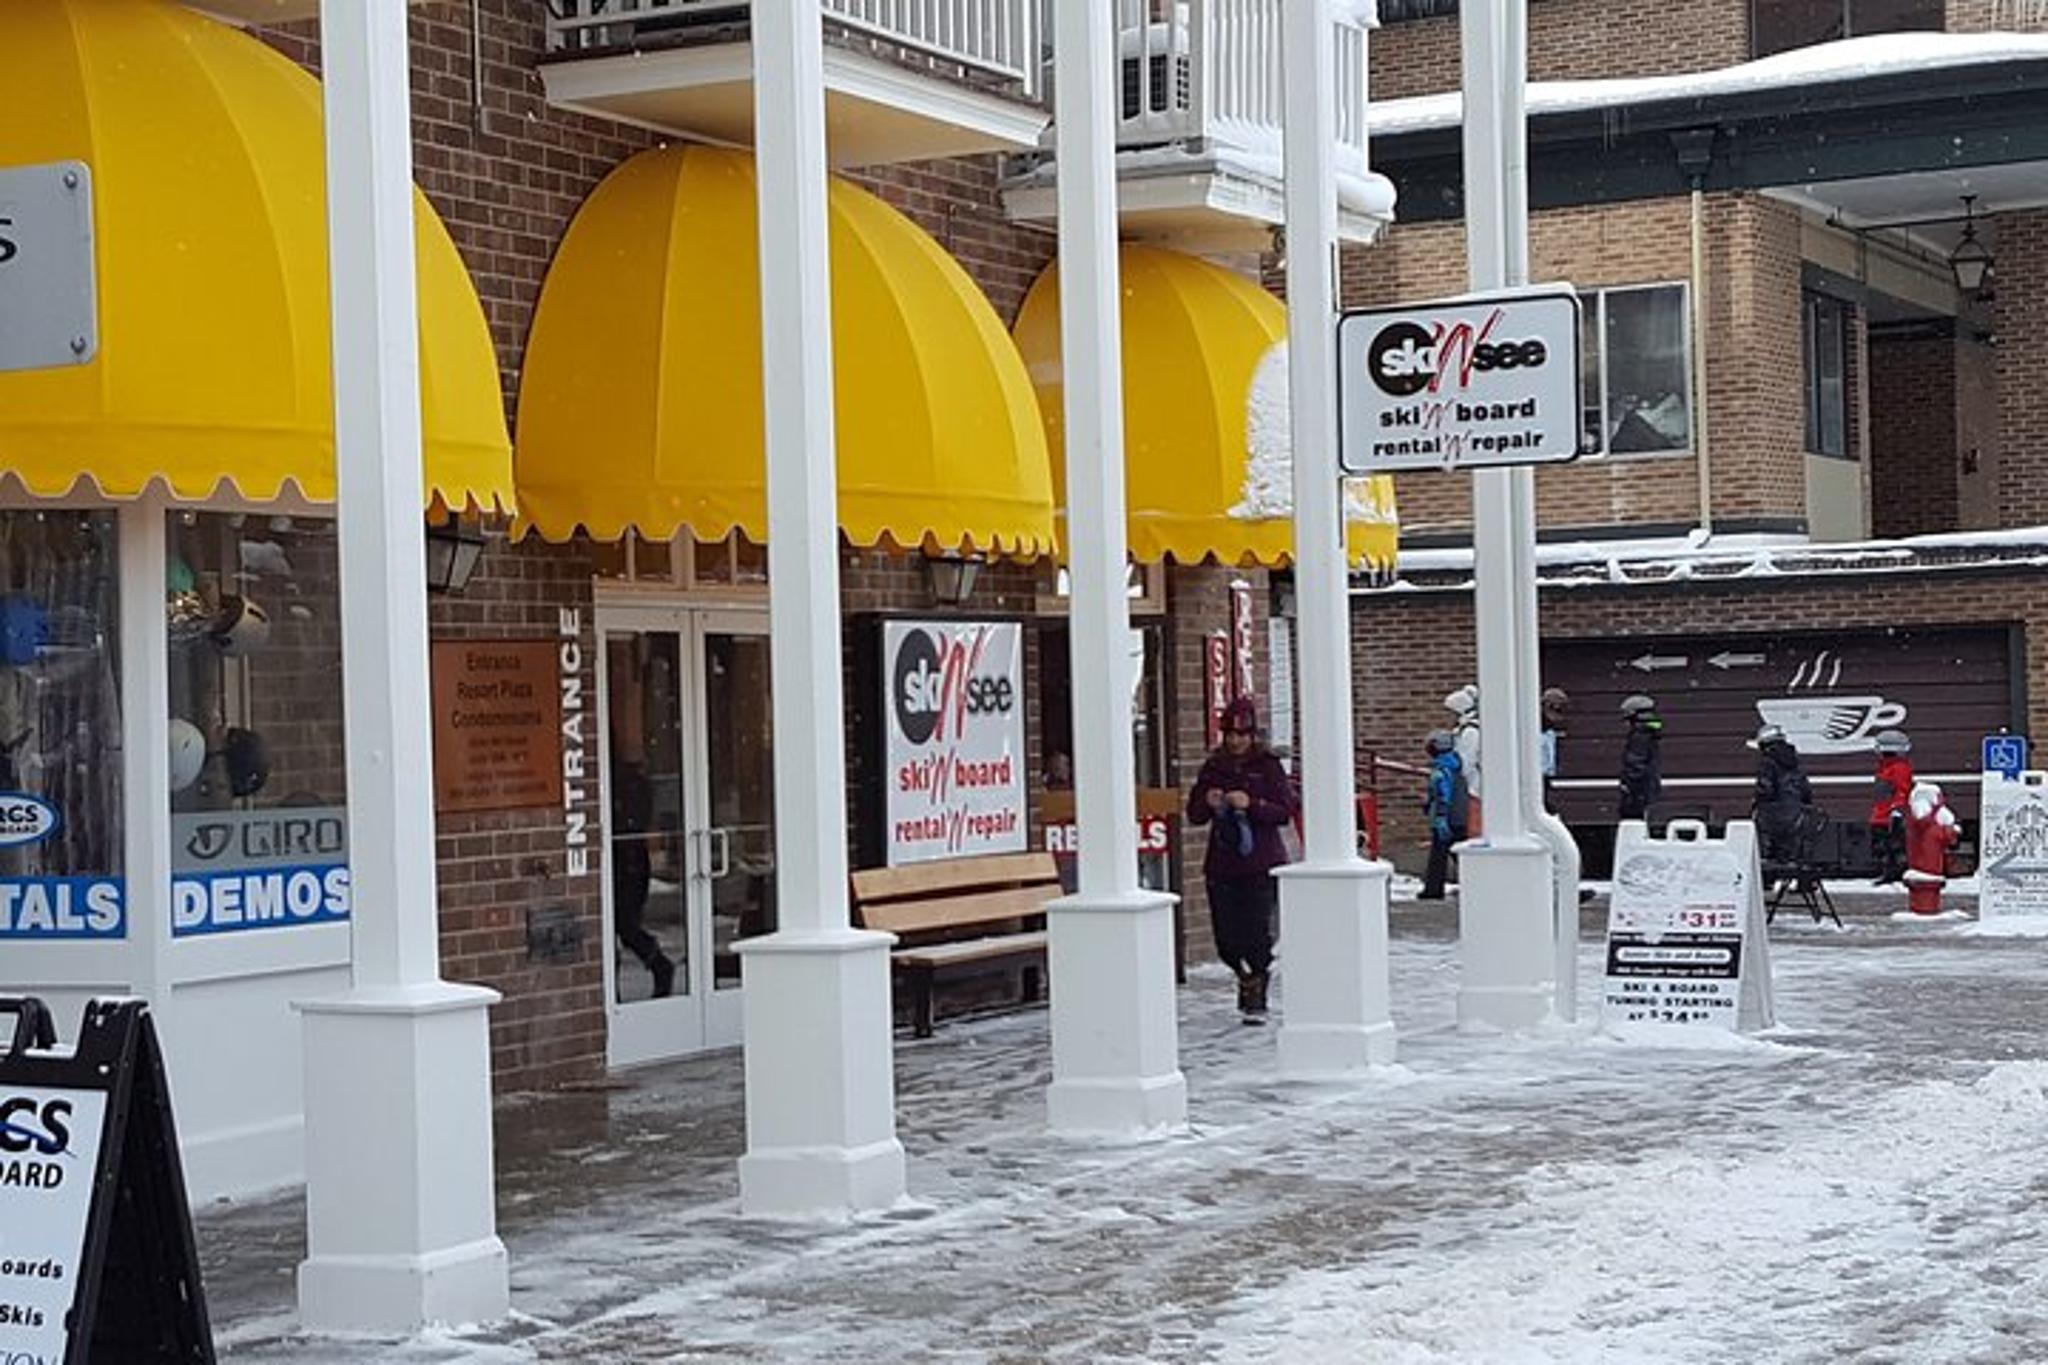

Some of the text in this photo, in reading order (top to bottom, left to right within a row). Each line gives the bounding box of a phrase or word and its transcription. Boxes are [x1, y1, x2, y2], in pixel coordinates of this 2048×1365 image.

[1379, 407, 1420, 428] ski
[1456, 398, 1536, 422] board
[1373, 436, 1441, 456] rental
[1472, 431, 1544, 454] repair
[559, 607, 588, 877] ENTRANCE
[899, 754, 930, 791] ski
[955, 755, 1011, 786] board
[242, 818, 343, 857] GIRO
[896, 813, 945, 842] rental
[967, 808, 1016, 839] repair
[1046, 821, 1168, 852] RELS
[173, 867, 350, 928] DEMOS
[1665, 997, 1734, 1008] STARTING
[1669, 983, 1719, 994] BOARD
[0, 1160, 63, 1189] ARD
